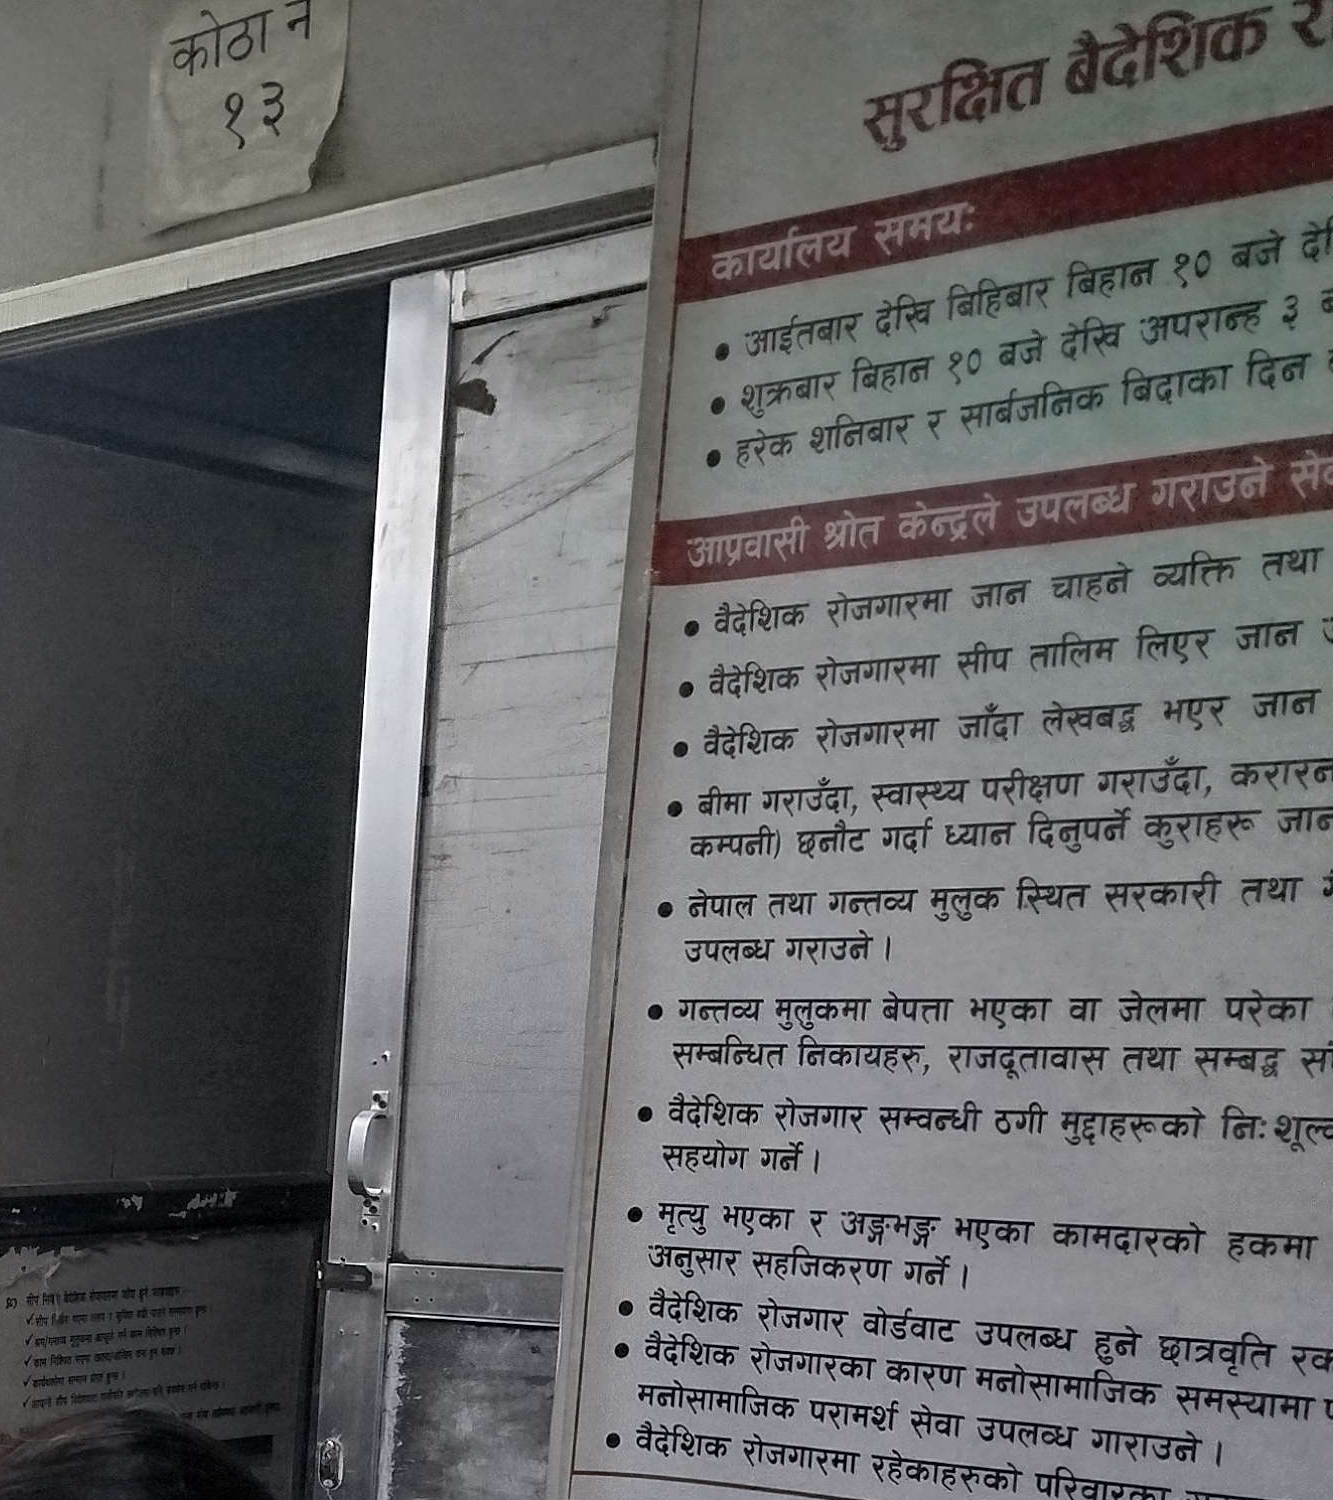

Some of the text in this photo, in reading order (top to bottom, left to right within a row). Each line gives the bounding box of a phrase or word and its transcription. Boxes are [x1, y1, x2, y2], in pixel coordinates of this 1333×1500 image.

[170, 9, 274, 76] कोठा
[225, 82, 284, 149] १३
[863, 57, 1050, 153] सुरक्षित
[712, 226, 858, 280] कार्यालय
[745, 230, 1286, 356] आईतबार देखि बिहिबार बिहान १० बजे
[741, 295, 1298, 419] शुक्रबार बिहान १० बजे देखि अपरान्ह ३
[737, 429, 797, 468] हरेक
[809, 414, 914, 454] शनिबार
[927, 410, 946, 440] र
[1121, 365, 1233, 405] बिदाका
[1246, 349, 1311, 390] दिन
[687, 457, 1274, 567] आप्रवासी श्रोत केन्द्रले उपलब्ध गराउने
[715, 547, 1324, 636] वैदेशिक रोजगारमा जान चाहने व्यक्ति तथा
[709, 661, 804, 699] वैदेशिक
[816, 654, 940, 691] रोजगारमा
[958, 641, 1013, 679] सीप
[1030, 632, 1119, 671] तालिम
[1136, 625, 1216, 664] लिएर
[1236, 620, 1304, 650] जान
[704, 689, 1322, 759] वैदेशिक रोजगारमा जाँदा लेखबद्ध भएर जान
[698, 786, 752, 815] बीमा
[872, 780, 970, 812] स्वास्थ्य
[981, 768, 1085, 805] परीक्षण
[691, 825, 780, 859] कम्पनी)
[797, 819, 870, 859] छनौट
[882, 817, 933, 854] गर्दा
[945, 822, 1016, 846] ध्यान
[1028, 807, 1131, 853] दिनुपर्ने
[1144, 810, 1262, 849] कुराहरू
[689, 889, 757, 919] नेपाल
[769, 893, 817, 918] तथा
[829, 890, 918, 916] गन्तव्य
[931, 887, 1005, 922] मुलुक
[1016, 876, 1091, 914] स्थित
[1105, 871, 1222, 912] सरकारी
[1241, 878, 1303, 906] तथा
[685, 930, 873, 965] उपलब्ध गराउने
[679, 990, 1313, 1030] गन्तव्य मुलुकमा बेपत्ता भएका वा जेलमा परेका
[673, 1035, 788, 1069] सम्बन्धित
[948, 1046, 1110, 1079] राजदूतावास
[1123, 1047, 1181, 1073] तथा
[1195, 1048, 1286, 1077] सम्बद्ध
[669, 1093, 763, 1128] वैदेशिक
[775, 1097, 868, 1133] रोजगार
[995, 1102, 1048, 1134] ठगी
[663, 1140, 803, 1173] सहयोग गर्ने
[648, 1245, 950, 1285] अनुसार सहजिकरण गर्ने
[658, 1203, 709, 1235] मृत्यु
[724, 1206, 795, 1235] भएका
[810, 1211, 827, 1237] र
[955, 1218, 1035, 1249] भएका
[1053, 1222, 1206, 1257] कामदारको
[1228, 1232, 1318, 1262] हकमा
[650, 1288, 743, 1323] वैदेशिक
[758, 1298, 849, 1337] रोजगार
[975, 1322, 1078, 1351] उपलब्ध
[1095, 1325, 1142, 1365] हुने
[1159, 1332, 1277, 1376] छात्रवृति
[645, 1330, 1316, 1420] वैदेशिक रोजगारका कारण मनोसामाजिक समस्यामा
[638, 1380, 799, 1419] मनोसामाजिक
[809, 1400, 899, 1431] परामर्श
[910, 1404, 965, 1439] सेवा
[636, 1421, 732, 1458] वैदेशिक
[743, 1434, 860, 1475] रोजगारमा
[871, 1450, 1023, 1493] रहेकाहरुको
